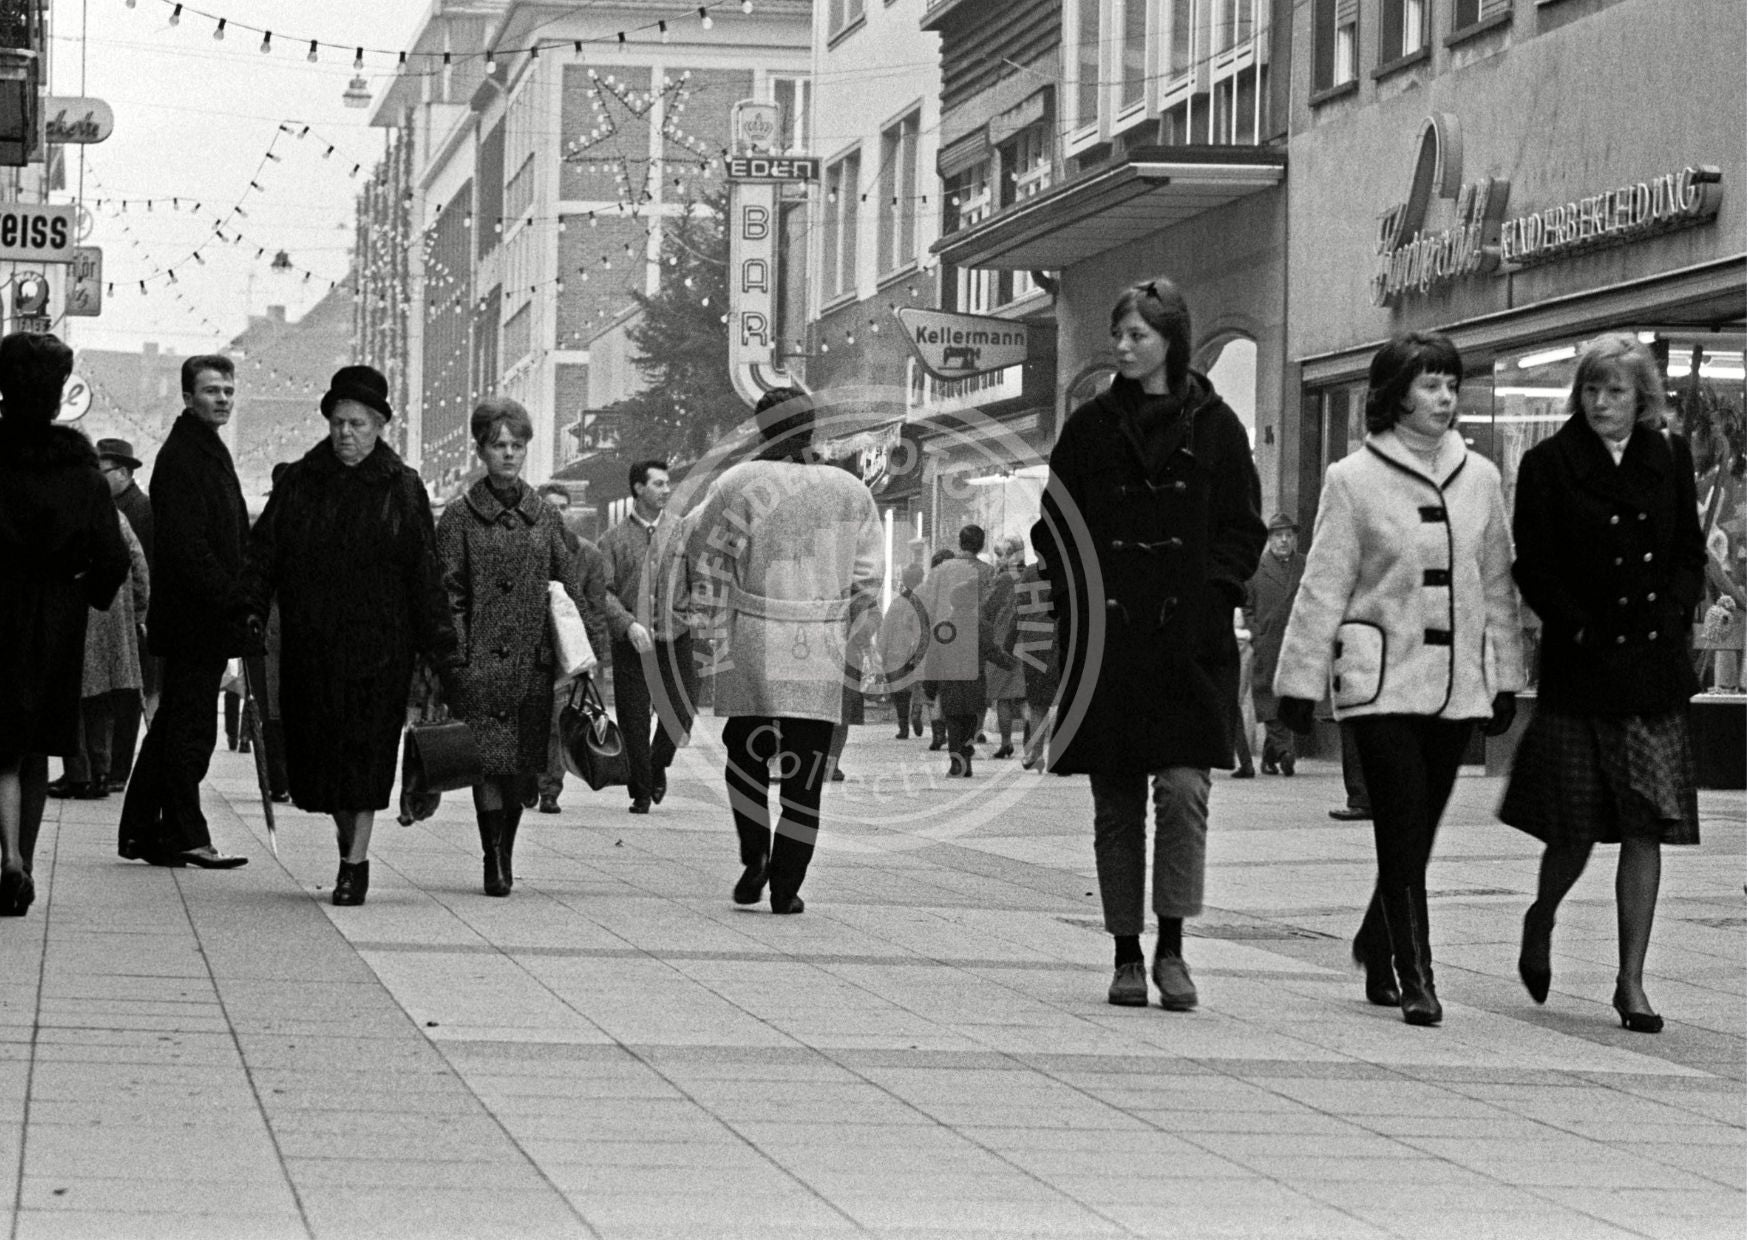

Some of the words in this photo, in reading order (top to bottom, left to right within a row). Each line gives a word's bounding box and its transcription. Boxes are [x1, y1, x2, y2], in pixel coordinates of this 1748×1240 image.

[731, 160, 812, 177] EDEN
[0, 213, 67, 249] eiss
[1501, 166, 1721, 260] KINDERBEKLEIDUNG
[742, 205, 769, 346] BAR
[915, 326, 1025, 345] Kellermann
